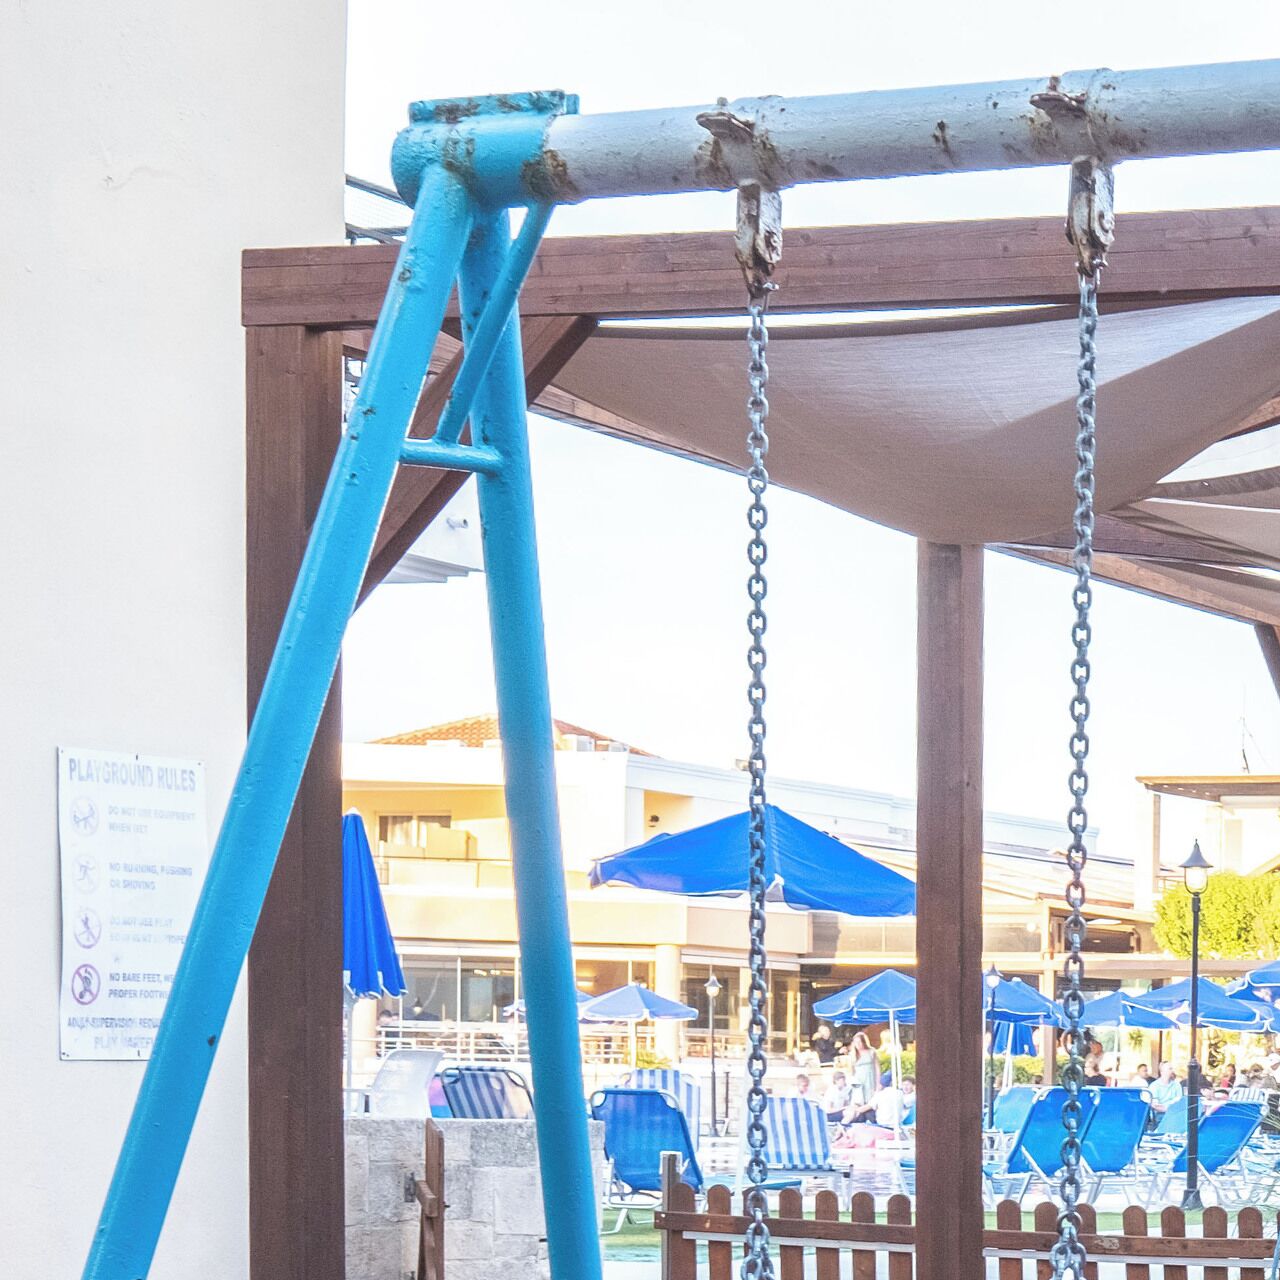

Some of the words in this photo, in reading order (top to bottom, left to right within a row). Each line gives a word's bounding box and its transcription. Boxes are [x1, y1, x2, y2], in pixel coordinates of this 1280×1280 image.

[69, 758, 154, 787] PLAYGROUND
[157, 767, 197, 791] RULES
[109, 973, 120, 982] NO
[122, 973, 141, 982] BARE
[108, 989, 137, 999] PROPER
